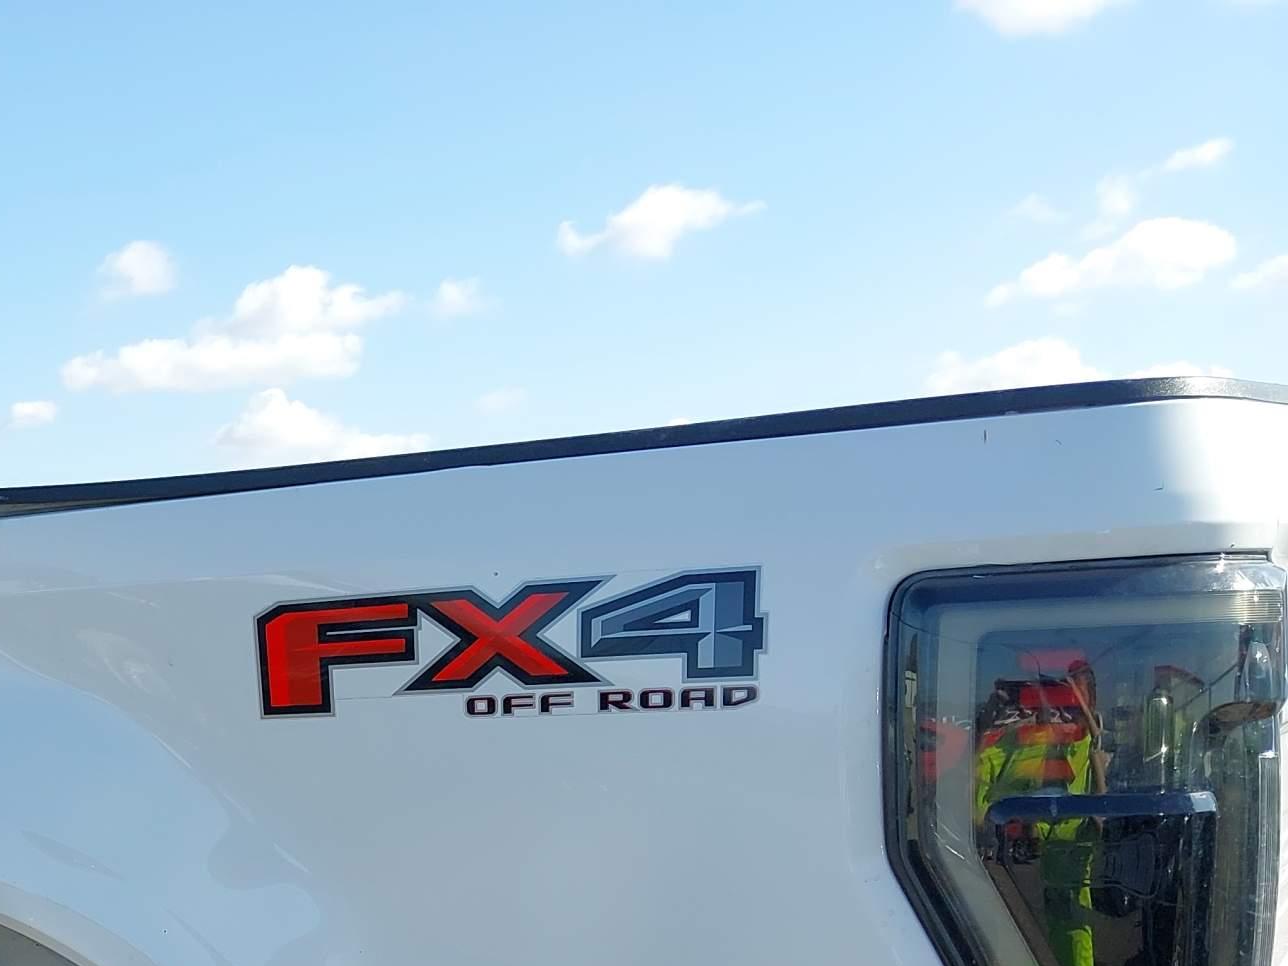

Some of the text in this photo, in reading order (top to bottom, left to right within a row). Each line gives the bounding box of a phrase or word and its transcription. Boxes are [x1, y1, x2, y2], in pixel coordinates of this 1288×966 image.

[255, 567, 767, 717] FX4
[466, 686, 758, 718] OFF ROAD
